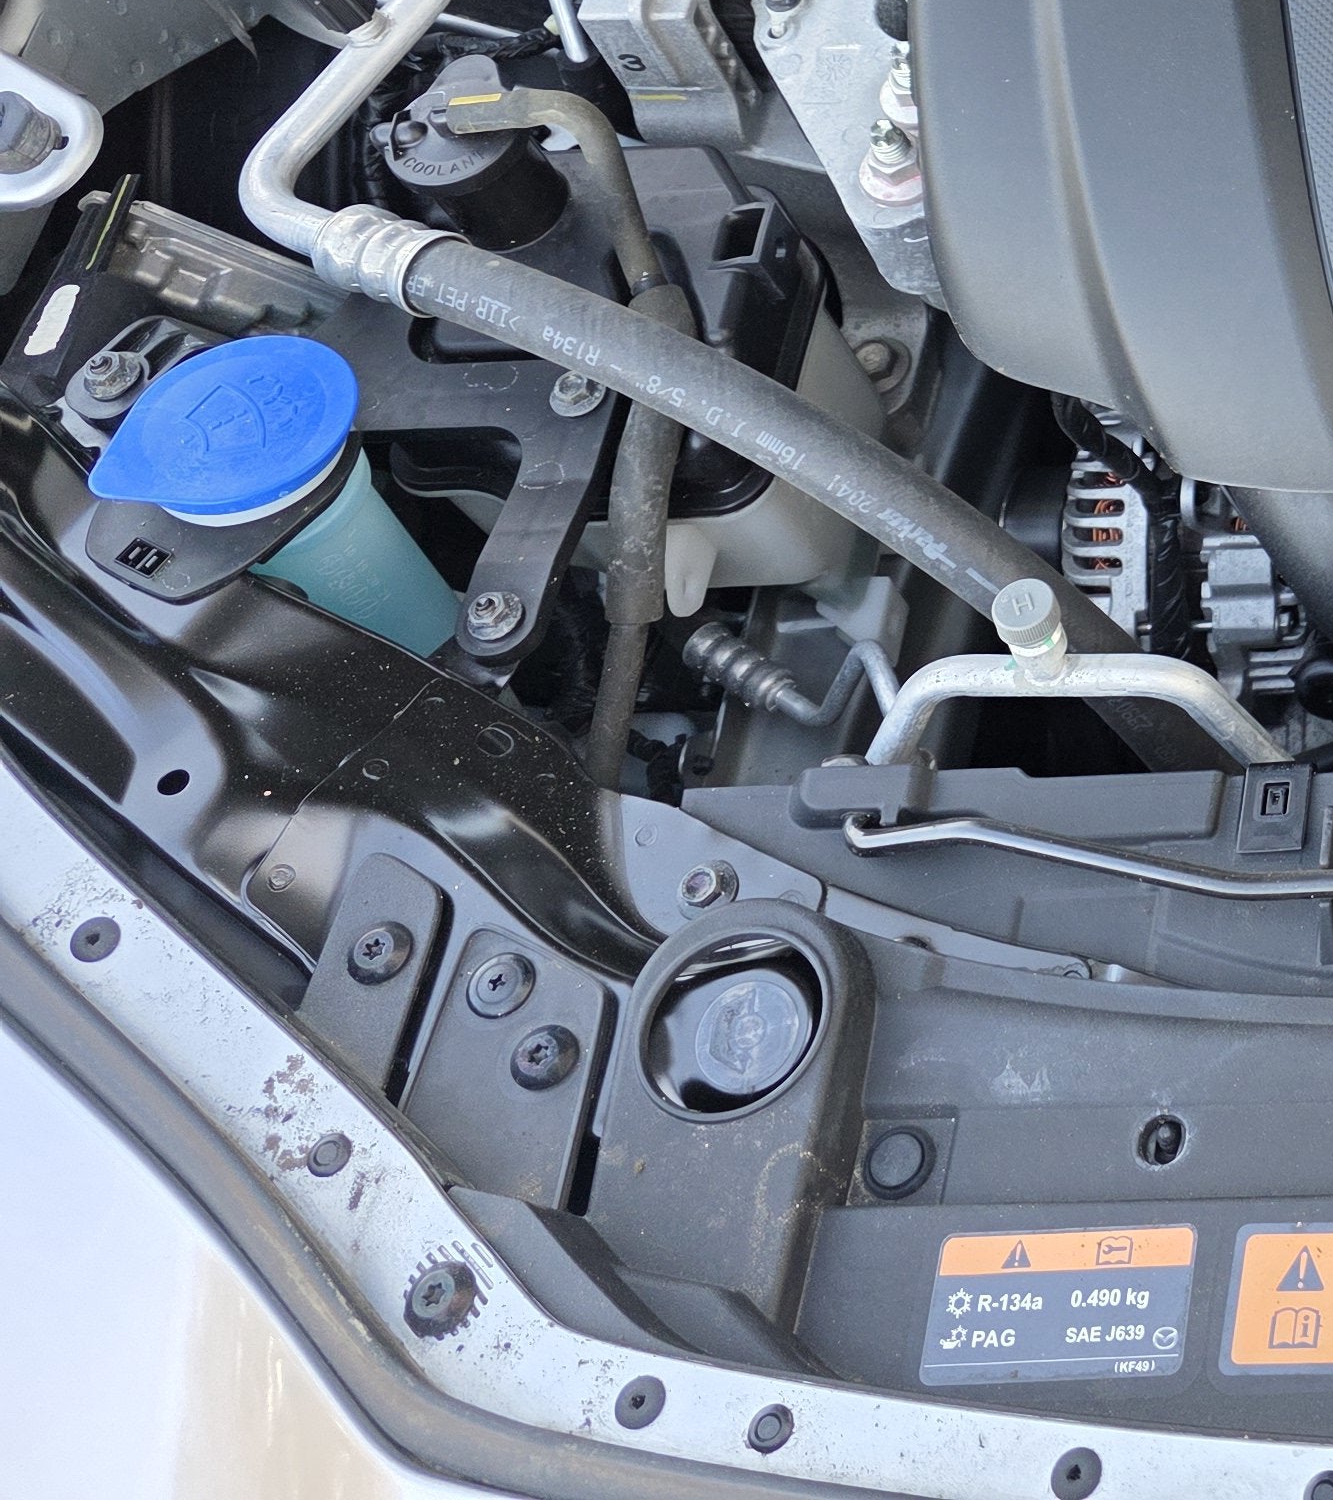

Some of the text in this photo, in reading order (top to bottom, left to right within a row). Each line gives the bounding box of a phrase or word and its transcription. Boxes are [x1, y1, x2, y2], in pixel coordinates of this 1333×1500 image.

[617, 53, 647, 72] 3
[403, 149, 485, 176] COOLANT
[537, 323, 601, 367] R134a
[751, 427, 807, 473] 16mm
[1012, 592, 1034, 616] H
[977, 1288, 1150, 1312] R-134a 0.490 kg
[971, 1325, 1145, 1347] PAG SAE J639
[1114, 1360, 1155, 1373] (KF49)
